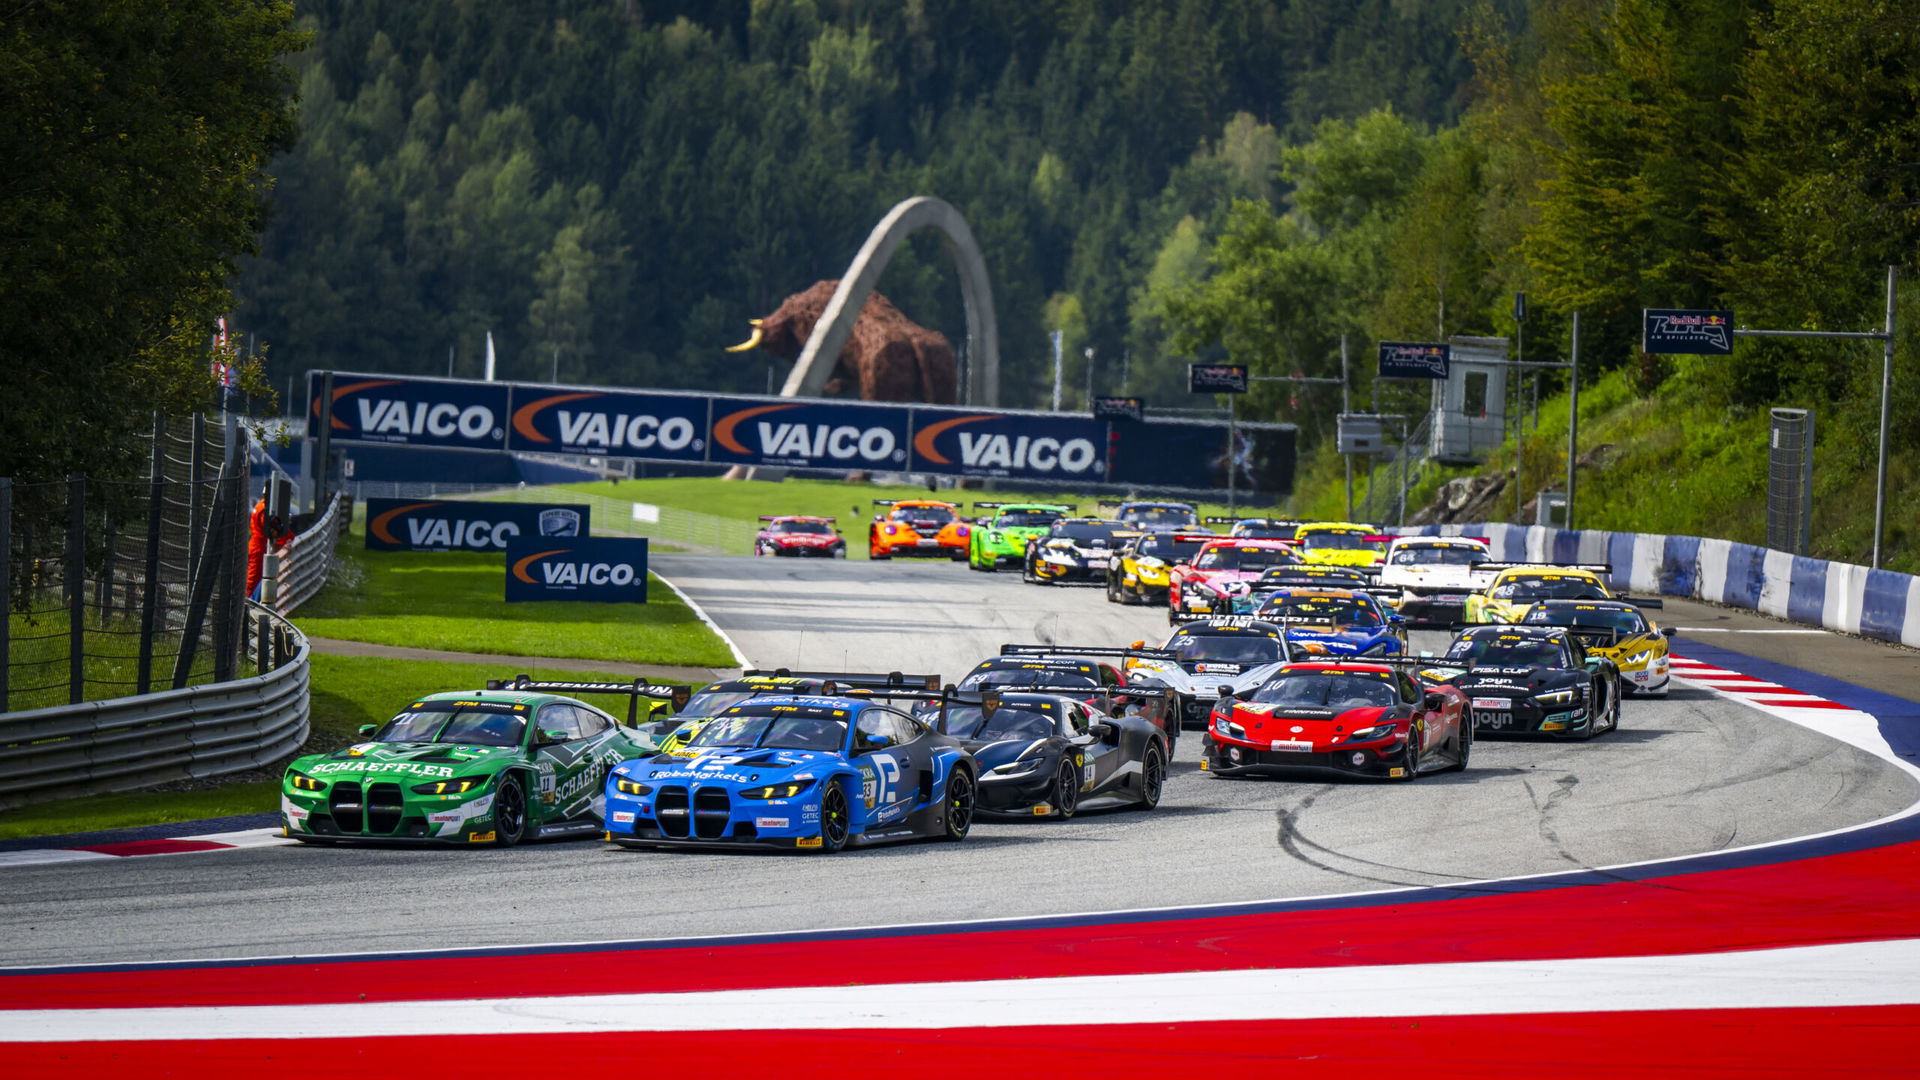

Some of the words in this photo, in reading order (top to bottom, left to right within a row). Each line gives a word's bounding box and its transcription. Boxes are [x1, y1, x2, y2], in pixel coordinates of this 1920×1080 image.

[358, 398, 494, 439] VAICO
[557, 410, 694, 450] VAICO
[758, 422, 895, 461] VAICO
[959, 432, 1096, 473] VAICO
[543, 562, 634, 586] VAICO
[1530, 612, 1547, 621] 19
[1174, 636, 1195, 647] 25
[1451, 641, 1474, 653] 29
[1265, 680, 1286, 691] 10
[308, 761, 454, 778] SCHAEFFLER
[654, 770, 748, 784] RoboMarkets
